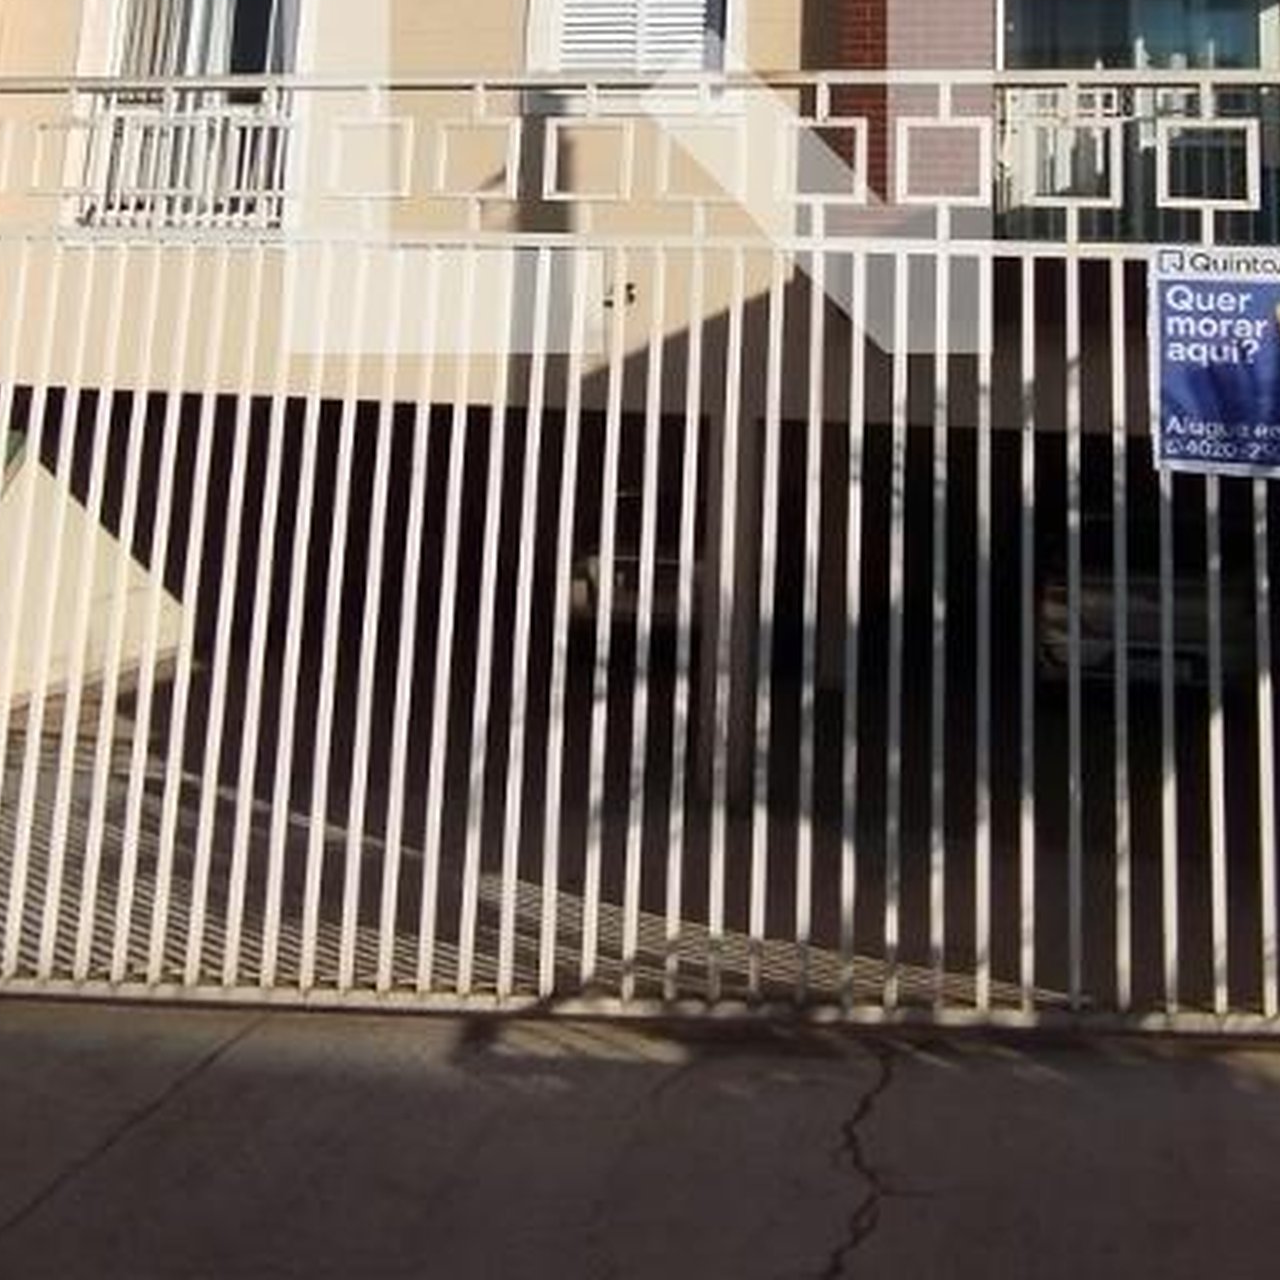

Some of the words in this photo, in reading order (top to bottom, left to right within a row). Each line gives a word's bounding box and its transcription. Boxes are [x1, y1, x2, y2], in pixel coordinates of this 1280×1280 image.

[1166, 285, 1252, 312] Quer
[1166, 319, 1268, 339] morar
[1167, 341, 1260, 367] aqui?
